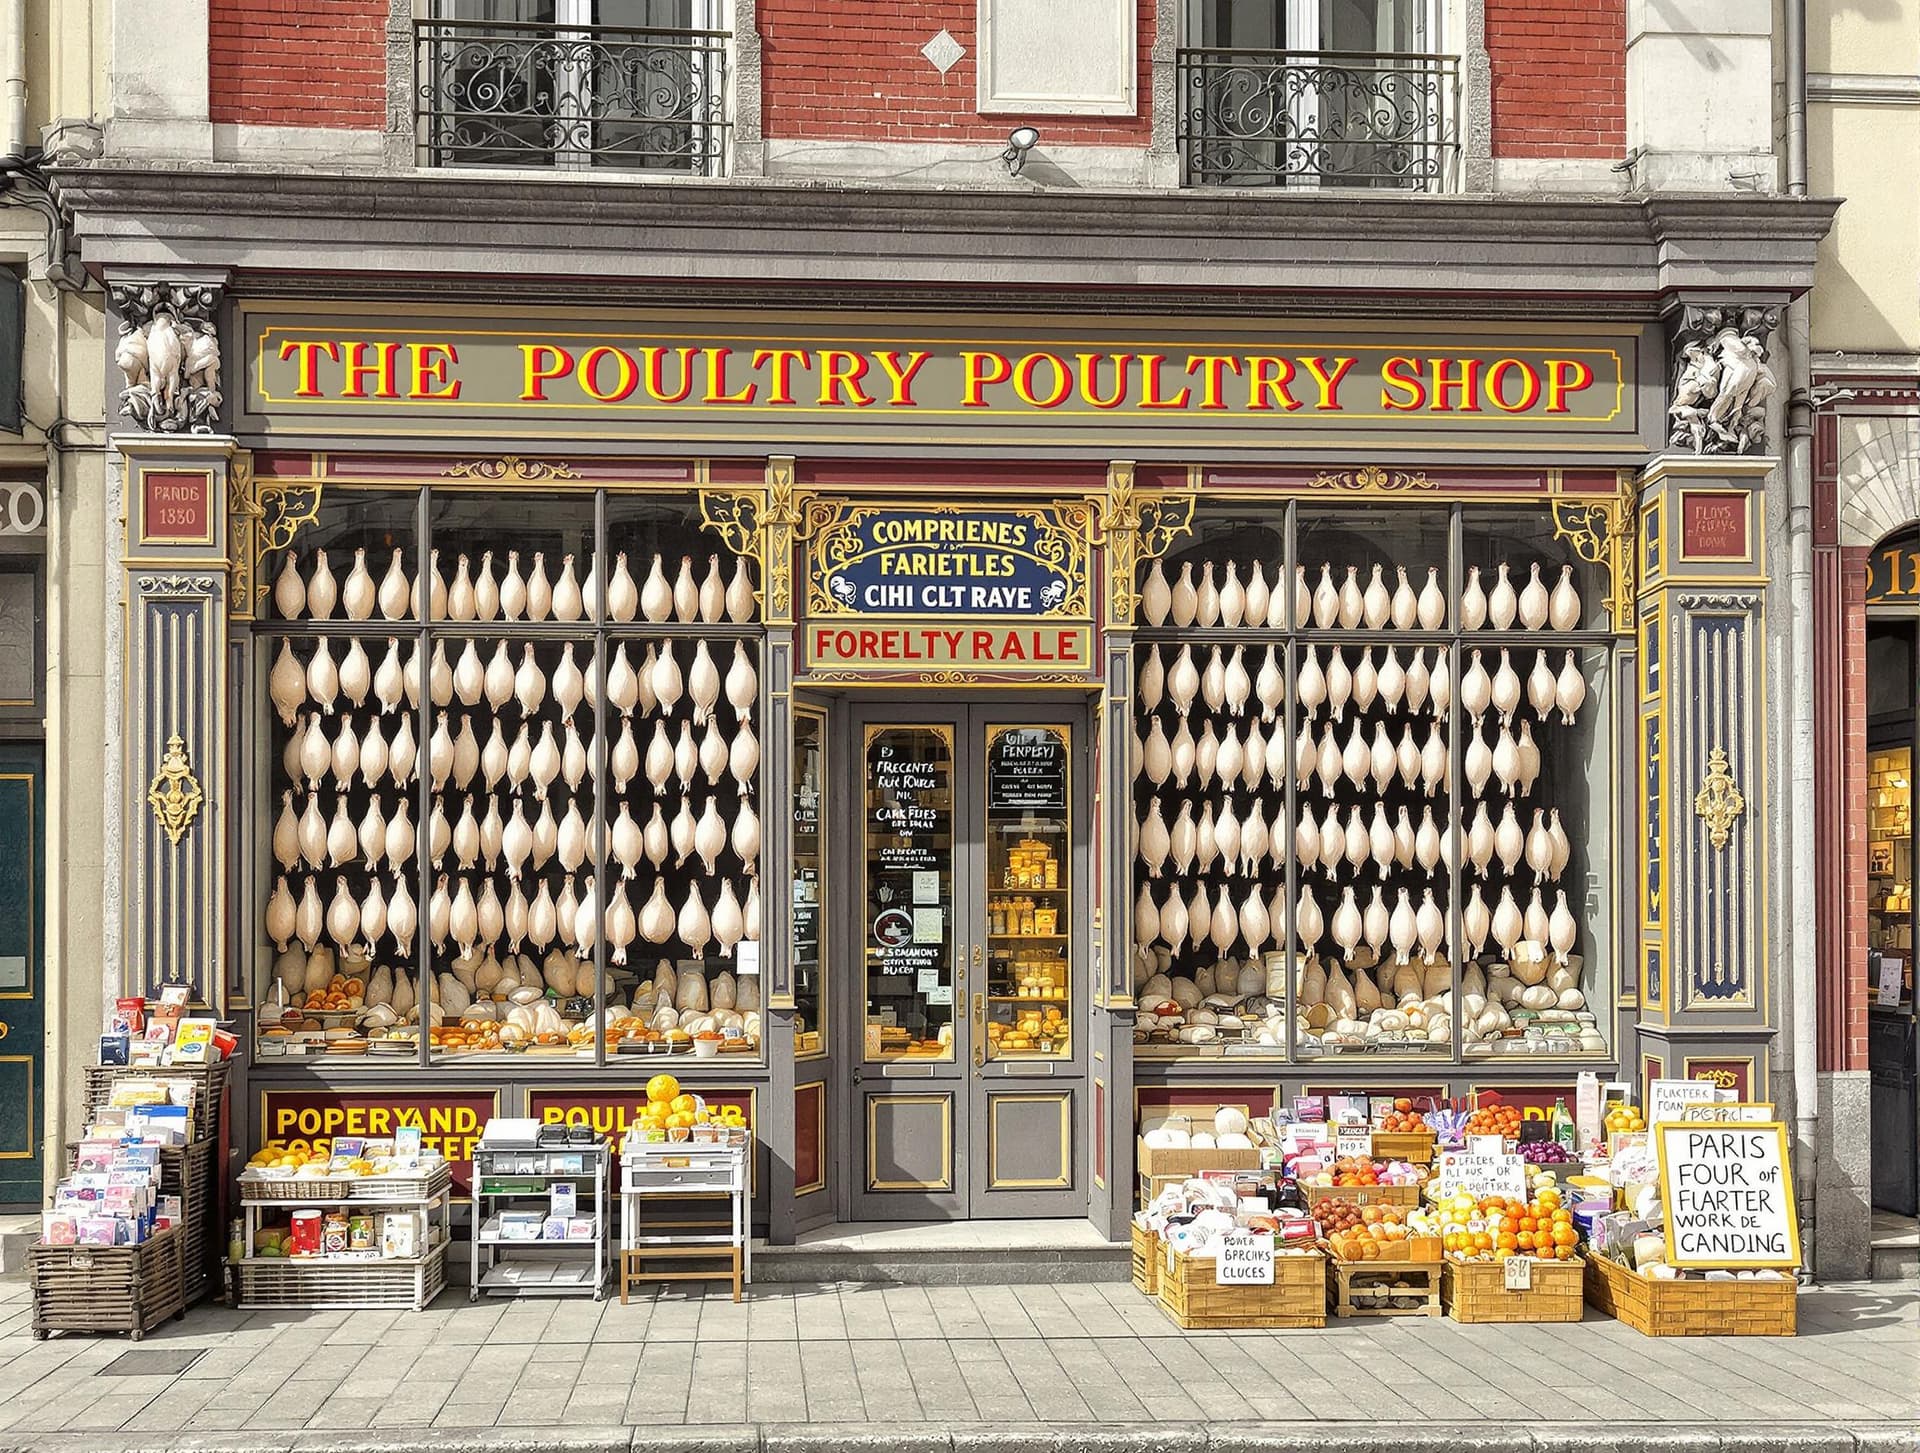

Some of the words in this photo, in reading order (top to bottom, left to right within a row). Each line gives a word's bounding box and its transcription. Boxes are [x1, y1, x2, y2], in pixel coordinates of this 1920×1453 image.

[278, 339, 462, 400] THE
[517, 343, 934, 407] POULTRY
[959, 351, 1359, 412] POULTRY
[1380, 356, 1595, 413] SHOP
[872, 519, 1027, 546] COMPRIENES
[880, 553, 1016, 577] FARIETLES
[864, 584, 914, 607] CIHI
[971, 586, 1032, 609] RAYE
[816, 630, 964, 659] FORELTY
[972, 631, 1079, 661] RALE
[1688, 1133, 1765, 1159] PARIS
[1678, 1162, 1750, 1187] FOUR
[1678, 1190, 1775, 1214] FLARTER
[1675, 1213, 1736, 1229] WORK
[1740, 1215, 1762, 1229] DE
[1680, 1232, 1786, 1255] CANDING
